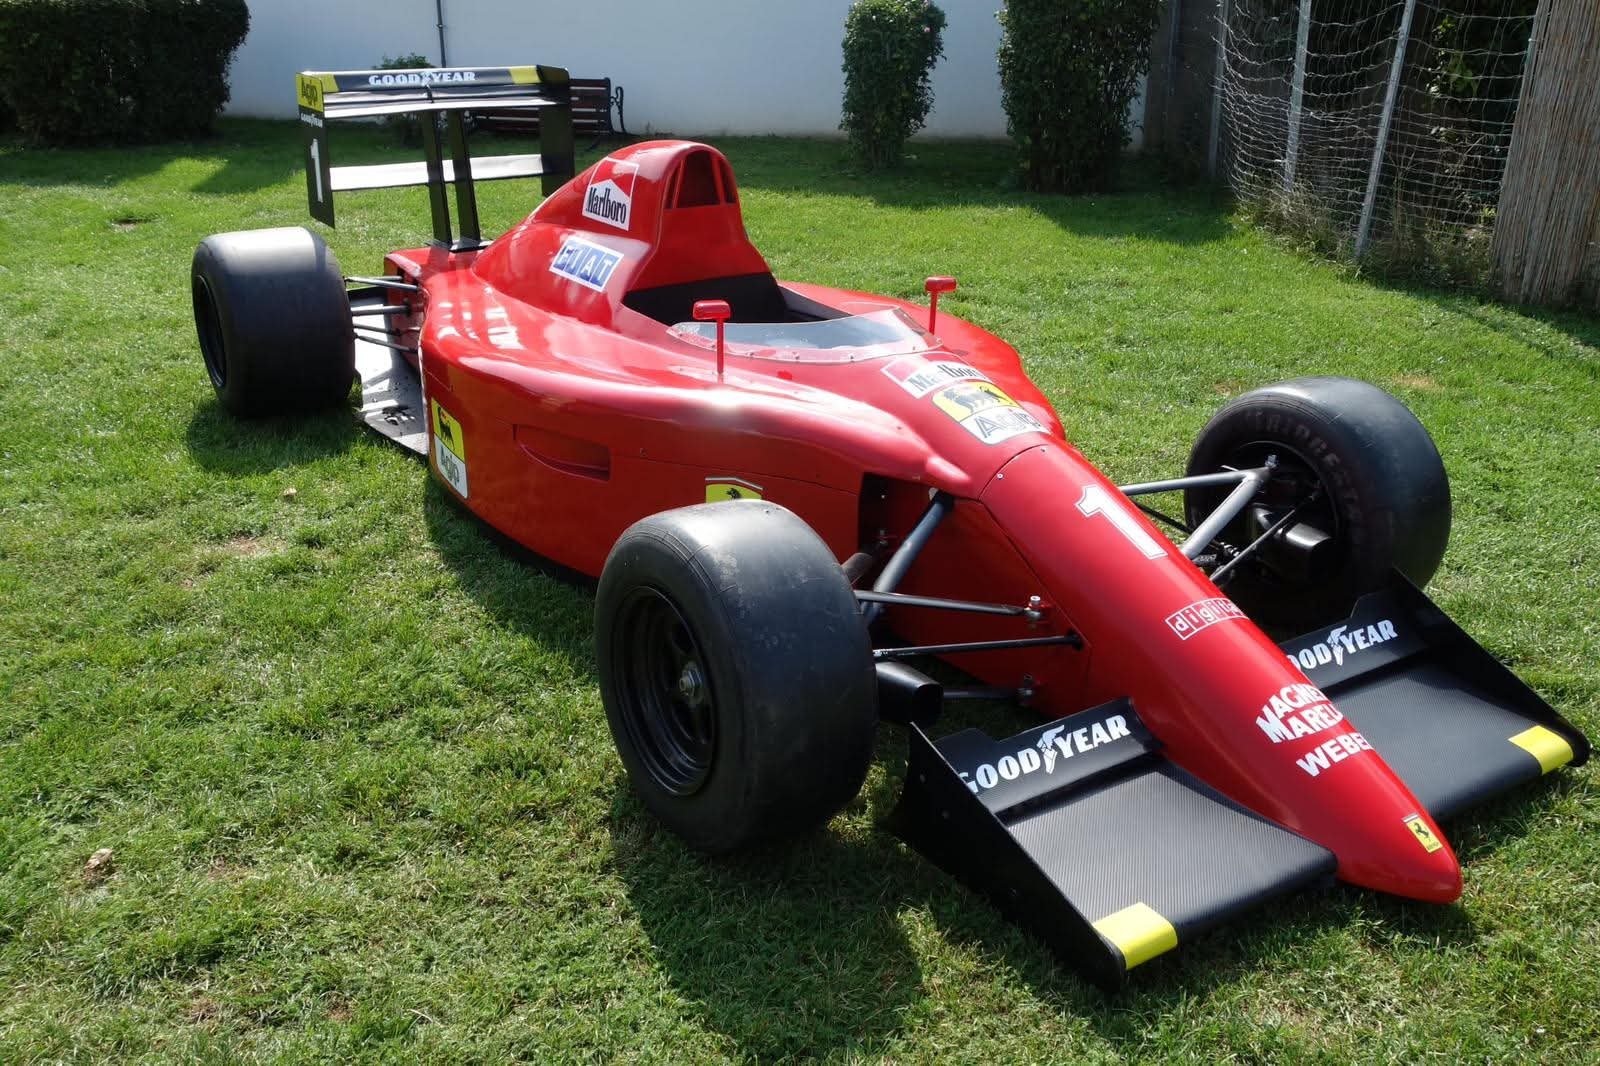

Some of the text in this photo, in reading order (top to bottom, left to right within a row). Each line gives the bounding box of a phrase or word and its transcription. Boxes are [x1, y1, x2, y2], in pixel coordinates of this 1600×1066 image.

[368, 71, 477, 85] GOODYEAR
[311, 138, 324, 203] 1
[585, 186, 627, 224] Marlboro
[557, 245, 614, 281] FIAT
[1075, 484, 1168, 560] 1
[1287, 619, 1398, 669] ODYEAR
[1256, 684, 1332, 738] MAGNE
[1296, 733, 1374, 776] WEBE
